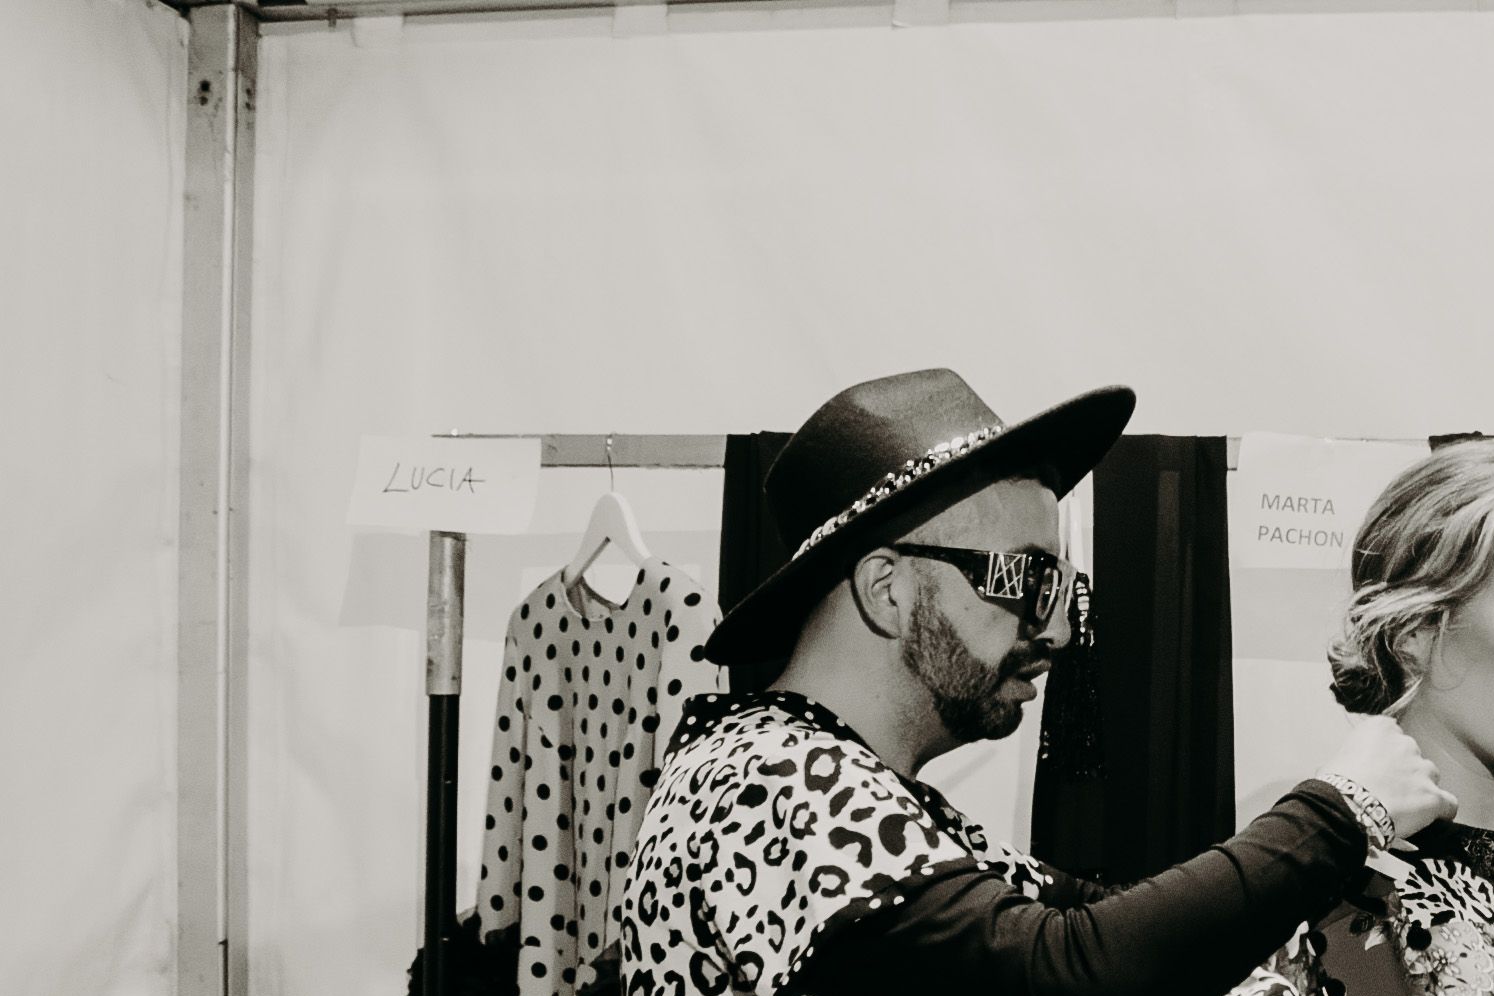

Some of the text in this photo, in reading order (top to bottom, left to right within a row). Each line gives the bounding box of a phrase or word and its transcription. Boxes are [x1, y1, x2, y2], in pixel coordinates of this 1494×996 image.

[381, 461, 486, 494] LUCIA
[1260, 493, 1336, 516] MARTA
[1257, 525, 1344, 548] PACHON
